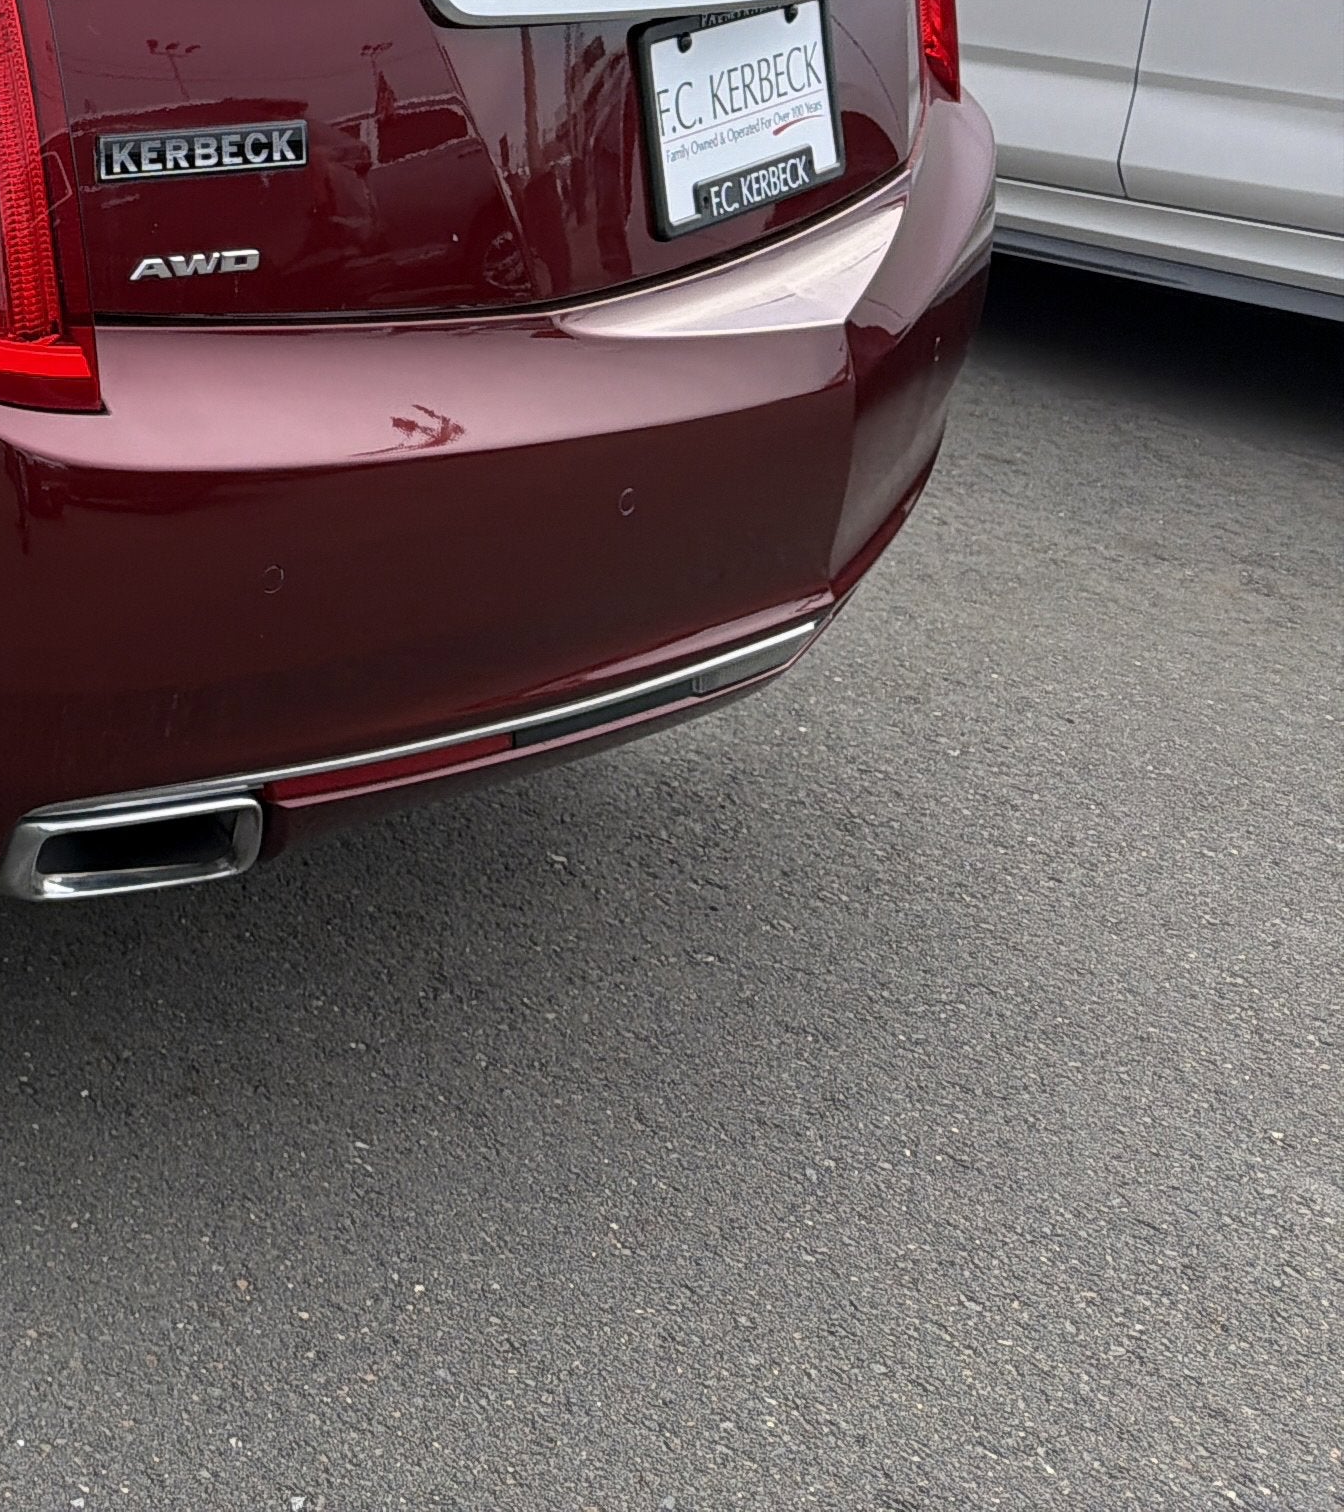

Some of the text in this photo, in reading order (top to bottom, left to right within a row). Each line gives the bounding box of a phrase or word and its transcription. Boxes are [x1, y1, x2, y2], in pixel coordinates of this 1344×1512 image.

[656, 40, 823, 137] F.C. KERBECK
[111, 129, 297, 174] KERBECK
[666, 141, 690, 163] Family
[691, 135, 719, 155] Owned
[727, 118, 760, 143] Operated
[760, 117, 772, 130] For
[773, 111, 790, 125] Over
[805, 101, 823, 115] Years
[710, 154, 810, 216] F.C. KERBECK
[129, 249, 260, 281] AWD
